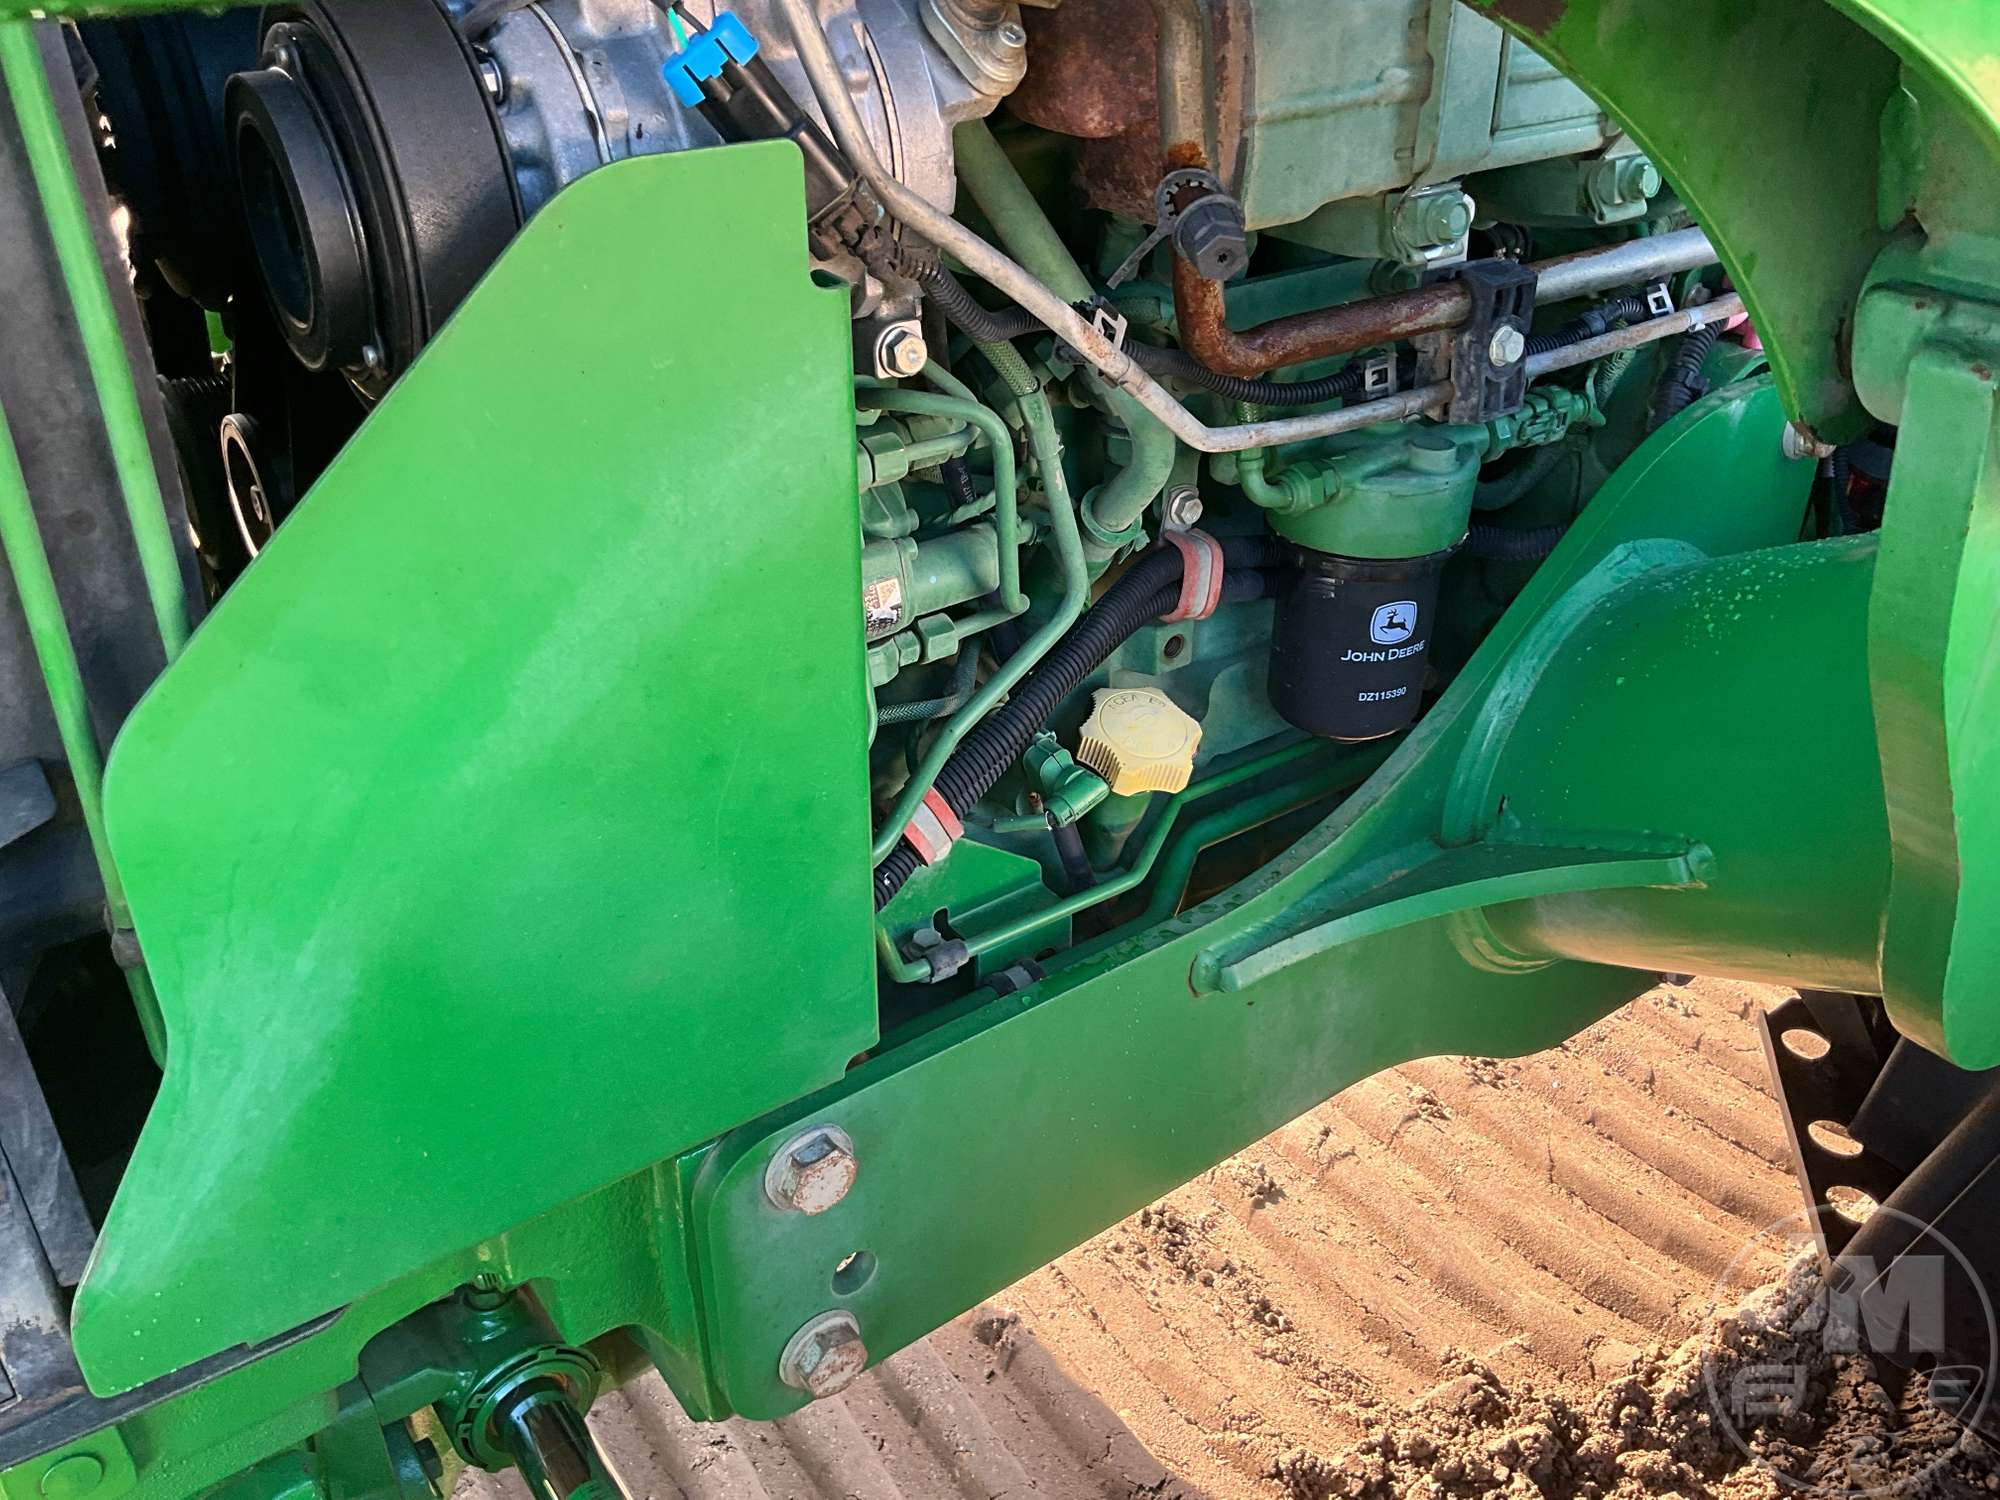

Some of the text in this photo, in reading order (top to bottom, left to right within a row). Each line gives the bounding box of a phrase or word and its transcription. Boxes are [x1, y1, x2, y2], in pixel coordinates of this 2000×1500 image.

[1340, 640, 1425, 662] JOHN DEERE
[1358, 686, 1407, 702] DZ115390
